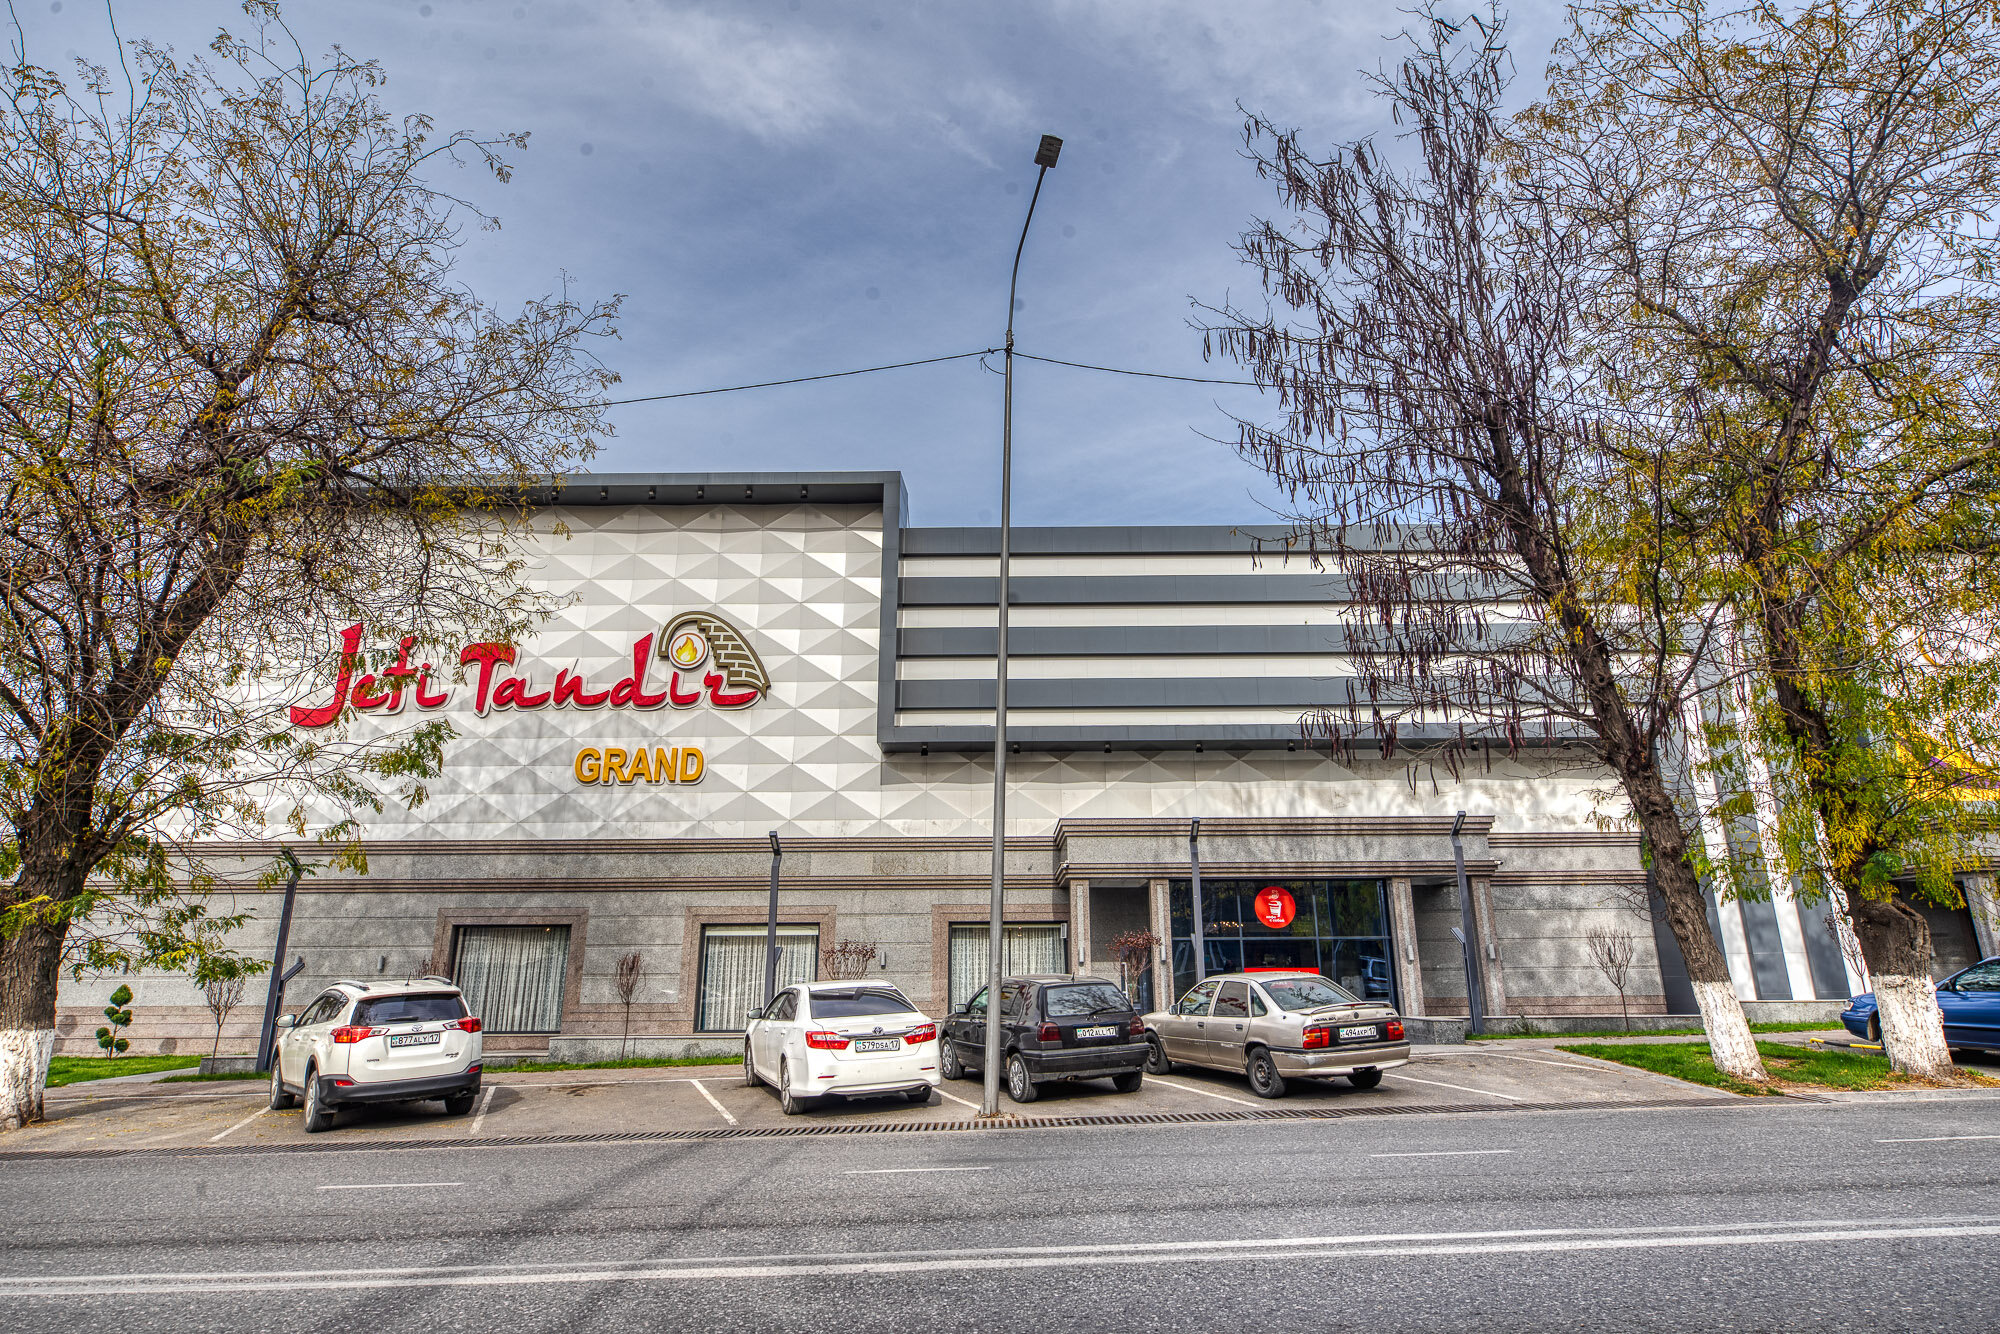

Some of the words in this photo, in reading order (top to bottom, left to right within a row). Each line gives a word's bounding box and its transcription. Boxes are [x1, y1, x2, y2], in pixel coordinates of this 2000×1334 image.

[460, 631, 758, 713] Tandir
[574, 747, 705, 784] GRAND
[1106, 1027, 1115, 1035] 17
[1368, 1026, 1377, 1035] 17
[429, 1033, 439, 1042] 17
[889, 1040, 899, 1048] 17
